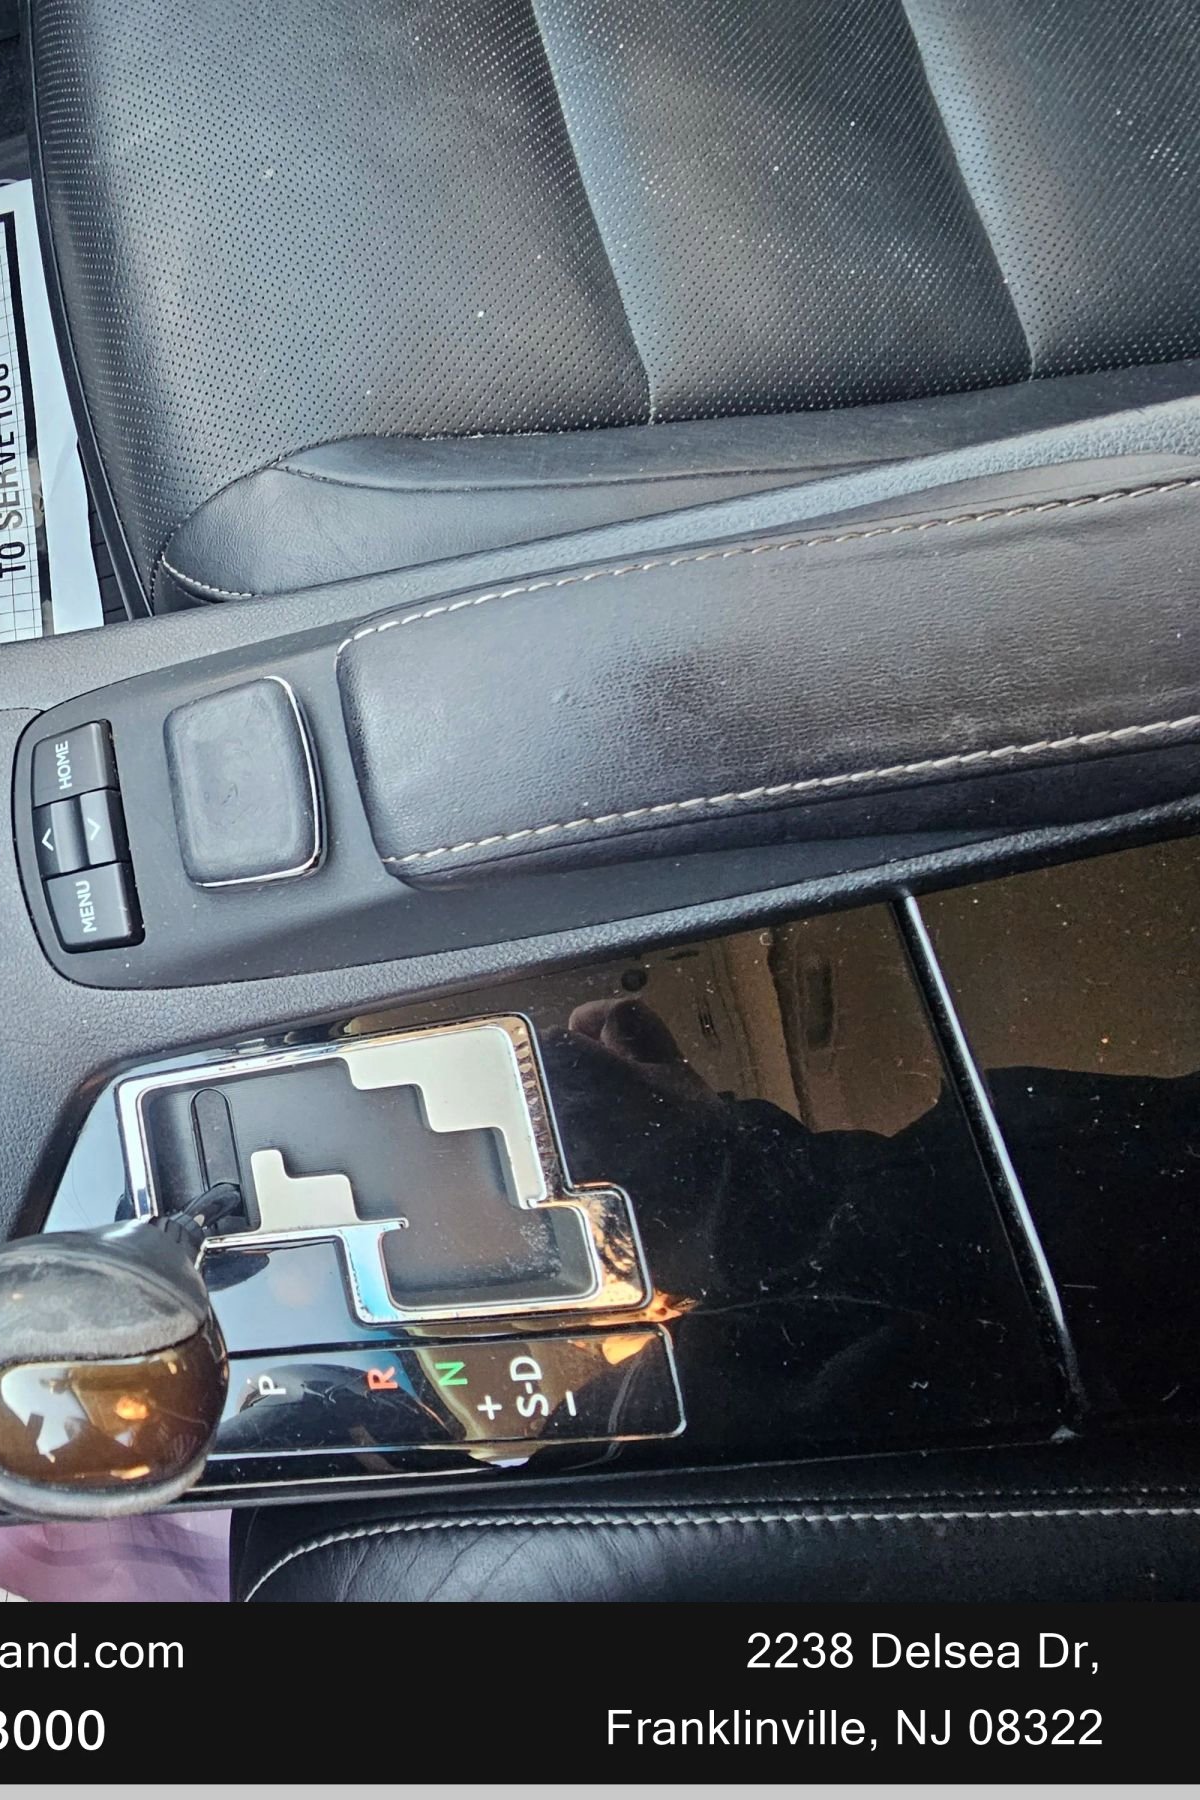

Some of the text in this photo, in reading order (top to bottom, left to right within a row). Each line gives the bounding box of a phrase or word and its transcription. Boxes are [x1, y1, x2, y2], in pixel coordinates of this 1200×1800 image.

[55, 740, 72, 790] HOME
[75, 880, 97, 934] MENU
[258, 1375, 286, 1396] P
[367, 1366, 398, 1391] R
[435, 1361, 468, 1387] N
